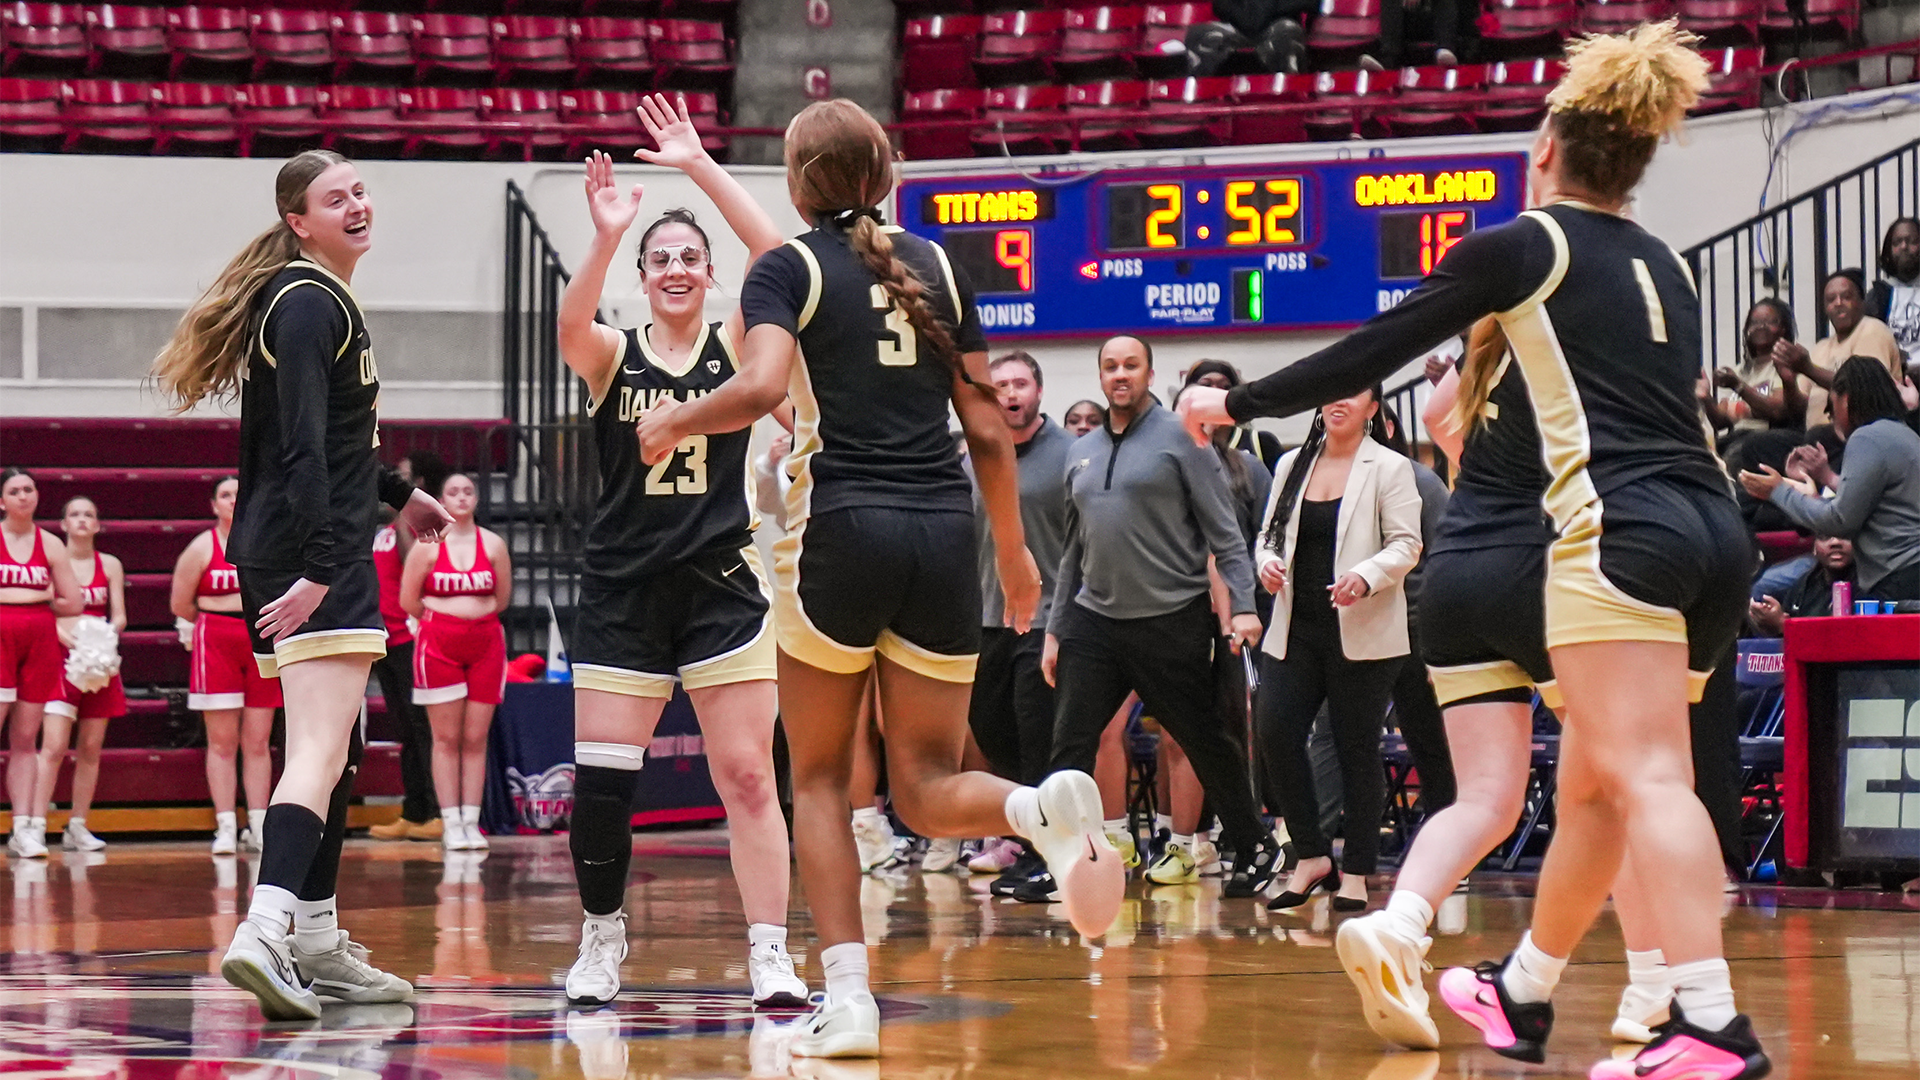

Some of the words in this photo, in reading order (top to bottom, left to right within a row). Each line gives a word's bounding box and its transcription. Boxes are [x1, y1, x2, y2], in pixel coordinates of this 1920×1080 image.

[1355, 170, 1496, 207] OAKLAND
[933, 190, 1037, 224] TITANS
[995, 230, 1031, 292] 9
[1103, 258, 1143, 277] POSS
[1265, 252, 1307, 271] POSS
[1145, 282, 1221, 306] PERIOD
[1248, 270, 1262, 322] 1
[870, 284, 917, 366] 3
[433, 571, 493, 591] TITANS
